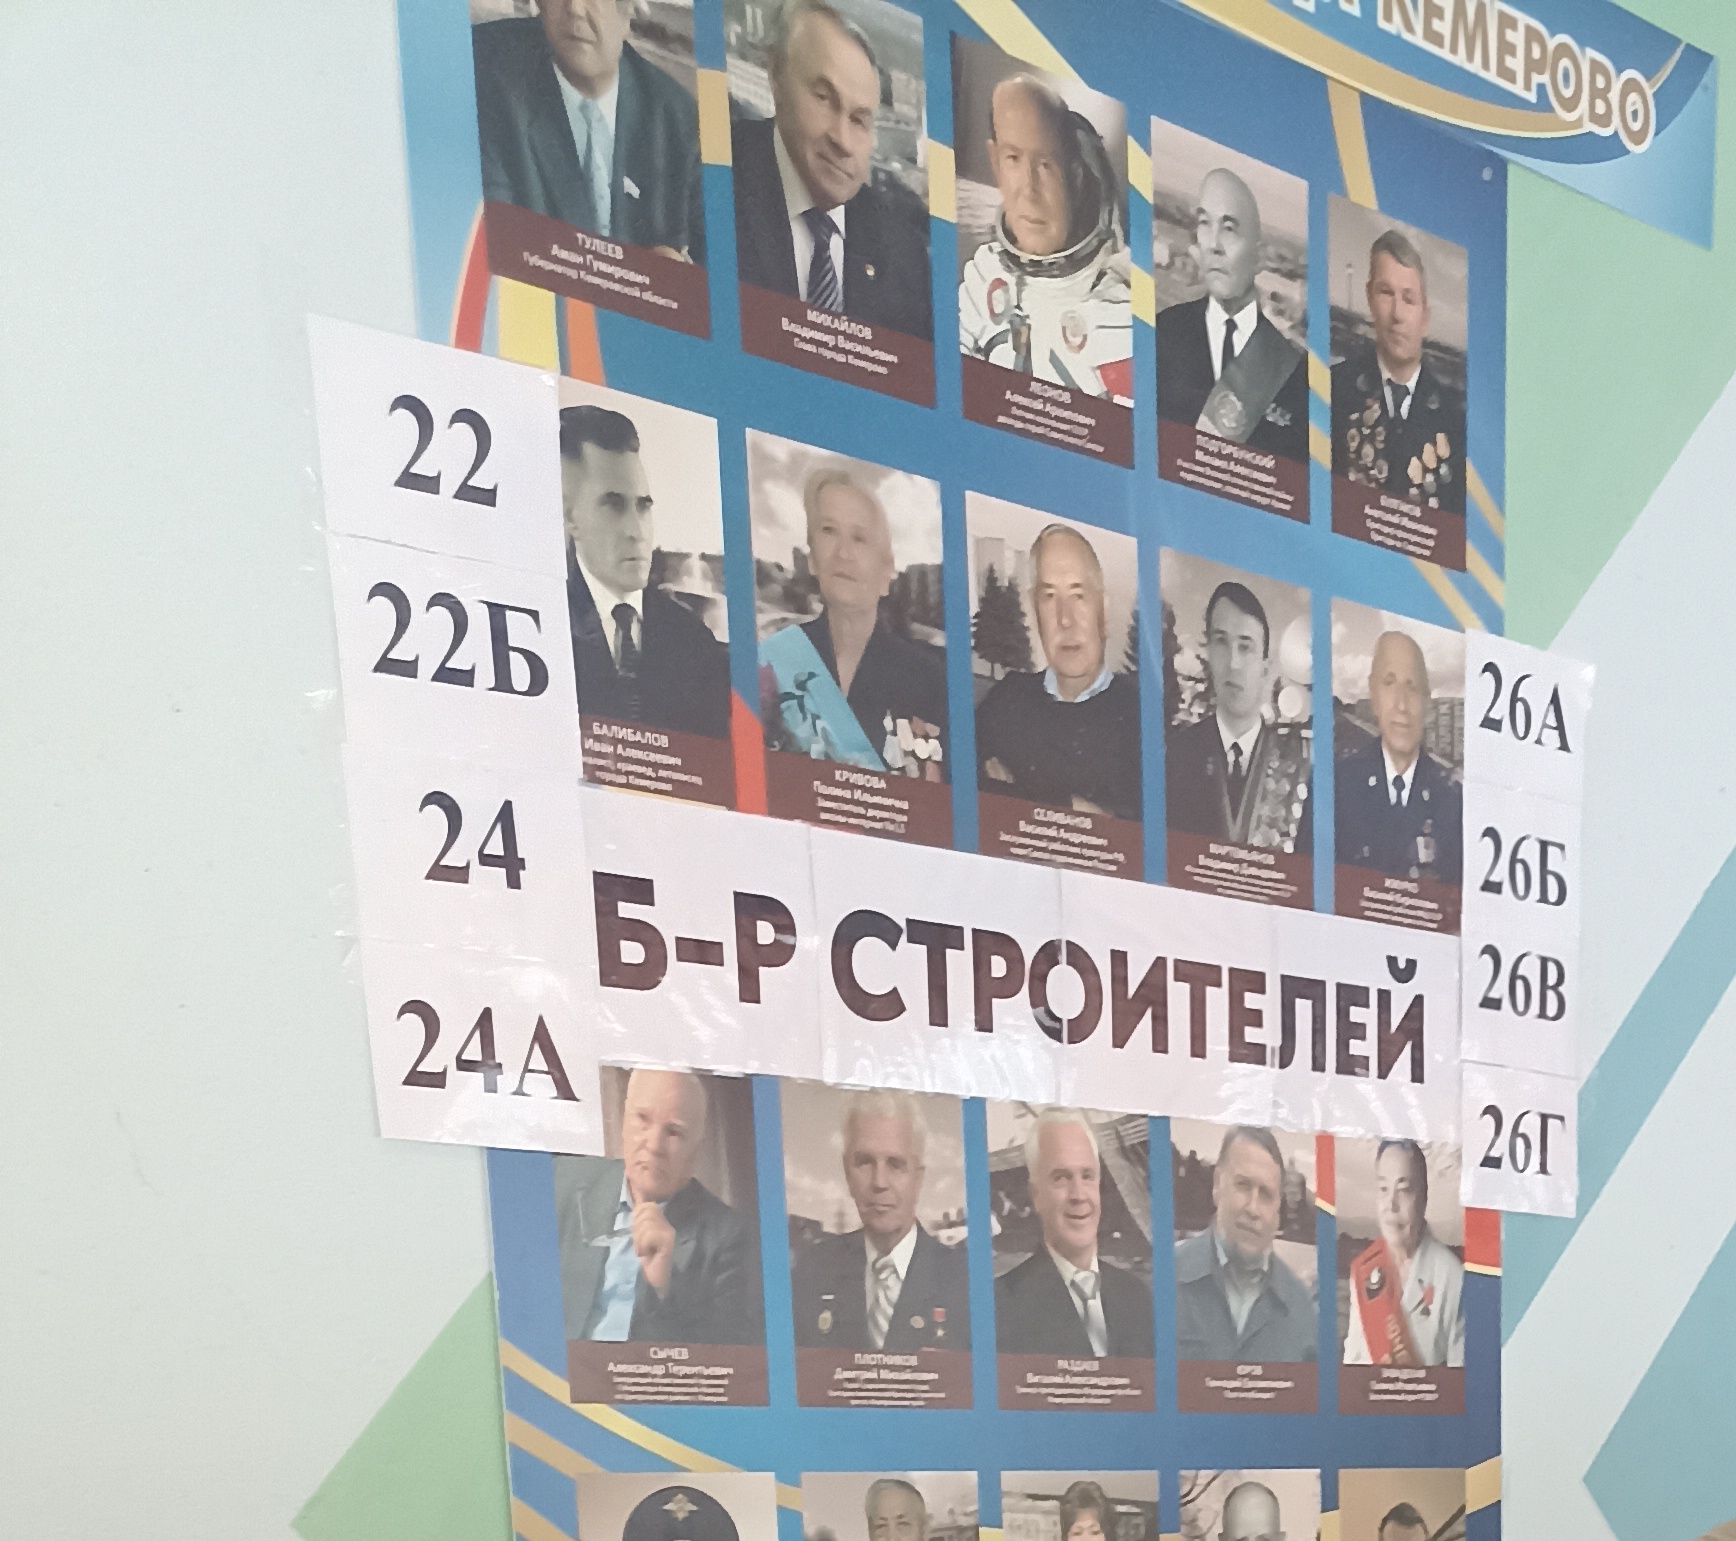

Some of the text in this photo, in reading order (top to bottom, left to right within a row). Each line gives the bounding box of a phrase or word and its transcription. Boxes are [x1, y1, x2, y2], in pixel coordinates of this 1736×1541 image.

[576, 233, 623, 259] ТУЛЕЕВ
[782, 317, 835, 347] Владимир
[807, 309, 872, 340] МИХАЙЛОВ
[389, 394, 500, 508] 22
[366, 581, 550, 698] 22Б
[592, 722, 669, 748] БАЛИБАЛОВ
[1479, 661, 1572, 754] 26А
[584, 737, 614, 754] Иван
[616, 744, 682, 766] Алексеевич
[834, 769, 886, 789] КРИВОВА
[419, 790, 527, 890] 24
[1479, 826, 1568, 907] 26Б
[591, 870, 1425, 1084] Б-Р СТРОИТЕЛЕЙ
[1479, 943, 1566, 1022] 26В
[396, 999, 581, 1103] 24А
[1479, 1104, 1567, 1177] 26Г
